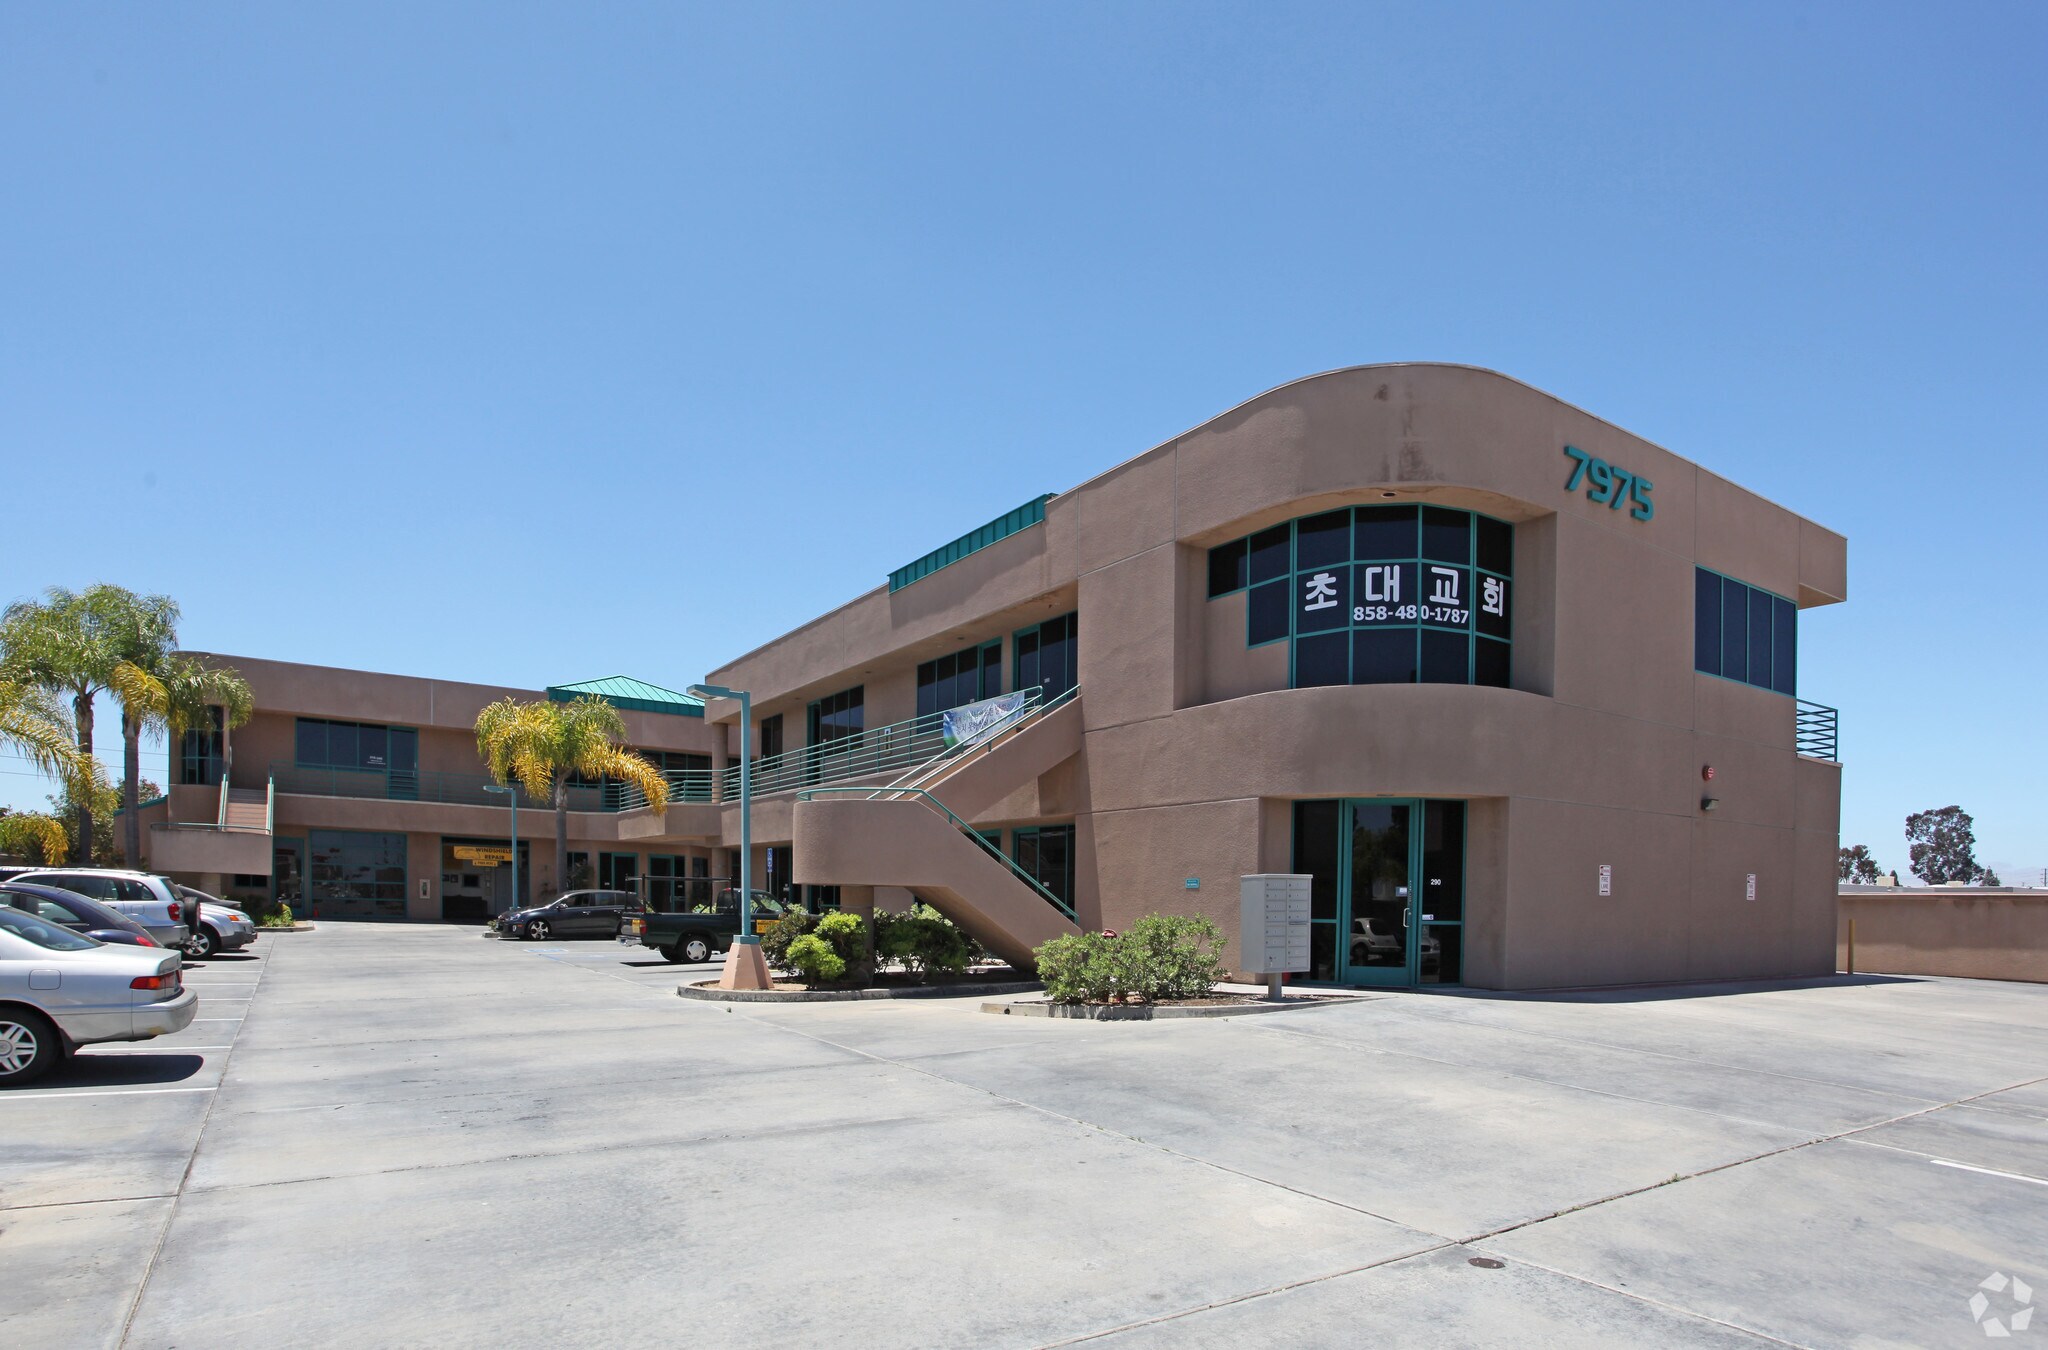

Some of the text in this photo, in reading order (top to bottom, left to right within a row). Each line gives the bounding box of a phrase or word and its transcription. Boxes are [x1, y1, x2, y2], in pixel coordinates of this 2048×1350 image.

[1563, 445, 1654, 522] 7975
[1353, 604, 1469, 624] 858-480-1787
[1430, 878, 1442, 886] 290
